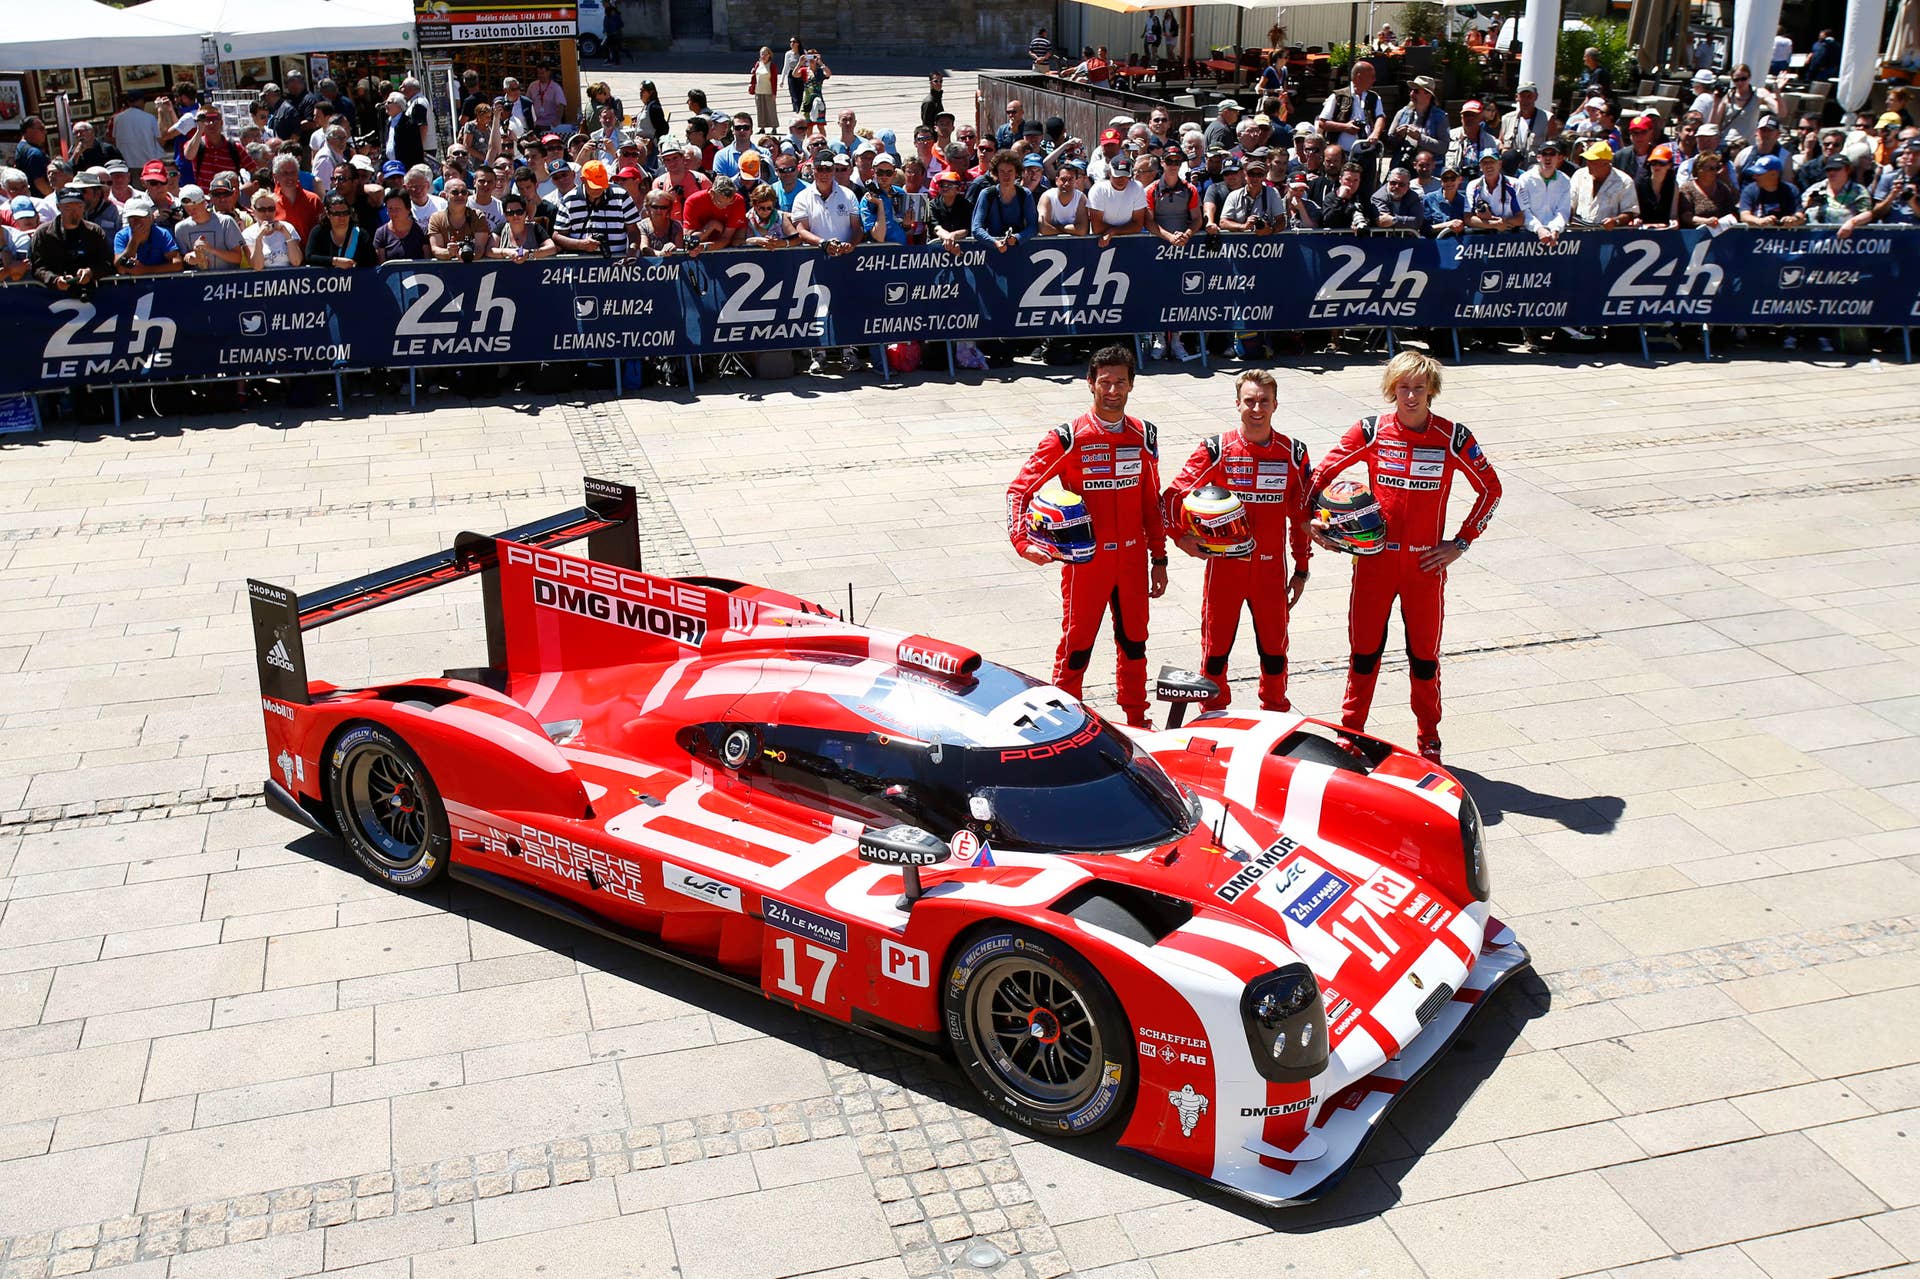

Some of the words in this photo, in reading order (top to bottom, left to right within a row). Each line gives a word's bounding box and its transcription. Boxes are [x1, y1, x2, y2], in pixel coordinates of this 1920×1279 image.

[459, 24, 570, 38] rs-automobiles.com
[1454, 240, 1581, 260] 24H-LEMANS.COM
[1752, 238, 1892, 255] 24H-LEMANS.COM
[855, 250, 986, 271] 24H-LEMANS.COM
[1608, 239, 1724, 297] 24h
[541, 264, 680, 285] 24H-LEMANS.COM
[1019, 247, 1130, 308] 24h
[1208, 275, 1256, 291] #LM24
[1314, 244, 1429, 301] 24h
[1505, 272, 1552, 289] #LM24
[1806, 270, 1860, 285] #LM24
[203, 276, 352, 301] 24H-LEMANS.COM
[717, 258, 832, 324] 24h
[911, 283, 960, 300] #LM24
[395, 271, 517, 335] 24h
[602, 300, 654, 316] #LM24
[1308, 302, 1341, 318] LE
[1343, 301, 1417, 317] MANS
[1454, 302, 1568, 319] LEMANS-TV.COM
[1602, 300, 1632, 316] LE
[1637, 299, 1712, 315] MANS
[1751, 299, 1874, 316] LEMANS-TV.COM
[271, 311, 326, 331] #LM24
[863, 314, 979, 334] LEMANS-TV.COM
[1015, 311, 1046, 327] LE
[1050, 308, 1123, 325] MANS
[1160, 305, 1274, 323] LEMANS-TV.COM
[43, 292, 177, 358] 24h
[713, 326, 746, 343] LE
[750, 321, 825, 340] MANS
[392, 338, 426, 356] LE
[431, 336, 512, 355] MANS
[553, 330, 676, 350] LEMANS-TV.COM
[219, 344, 351, 365] LEMANS-TV.COM
[41, 360, 79, 379] LE
[84, 352, 172, 376] MANS
[585, 482, 622, 494] CHOPARD
[1085, 481, 1112, 489] DMG
[1117, 477, 1139, 489] MORI
[1378, 475, 1405, 487] DMG
[1409, 480, 1439, 489] MORI
[1052, 515, 1091, 528] PORSC
[1337, 503, 1380, 521] PORSC
[508, 546, 706, 612] PORSCHE
[248, 584, 287, 600] CHOPARD
[534, 578, 611, 620] DMG
[617, 598, 706, 645] MORI
[729, 596, 757, 632] HY
[266, 655, 294, 672] adidas
[900, 646, 940, 672] Mobil
[941, 652, 957, 673] 1
[1159, 688, 1209, 698] CHOPARD
[262, 699, 286, 717] Mobil
[340, 730, 370, 749] MICHELIN
[1000, 714, 1103, 763] PORSC
[521, 825, 641, 872] PORSCHE
[859, 844, 936, 864] CHOPARD
[958, 840, 971, 856] E
[1218, 866, 1263, 902] DMG
[1255, 837, 1299, 869] MOR
[1276, 863, 1306, 893] WEC
[684, 875, 732, 899] WEC
[1308, 895, 1320, 907] LE
[1317, 878, 1339, 898] MANS
[1371, 874, 1406, 899] P1
[767, 904, 790, 922] 24h
[792, 917, 806, 929] LE
[807, 922, 841, 941] MANS
[1332, 900, 1400, 972] 17
[965, 937, 1011, 963] MICHELIN
[776, 937, 838, 1004] 17
[889, 949, 921, 981] P1
[1334, 1007, 1362, 1035] CHOPARD
[1140, 1027, 1207, 1048] SCHAEFFLER
[1180, 1054, 1206, 1066] FAG
[1073, 1088, 1112, 1127] MICHELIN
[1241, 1106, 1280, 1117] DMG
[1283, 1096, 1318, 1115] MORI
